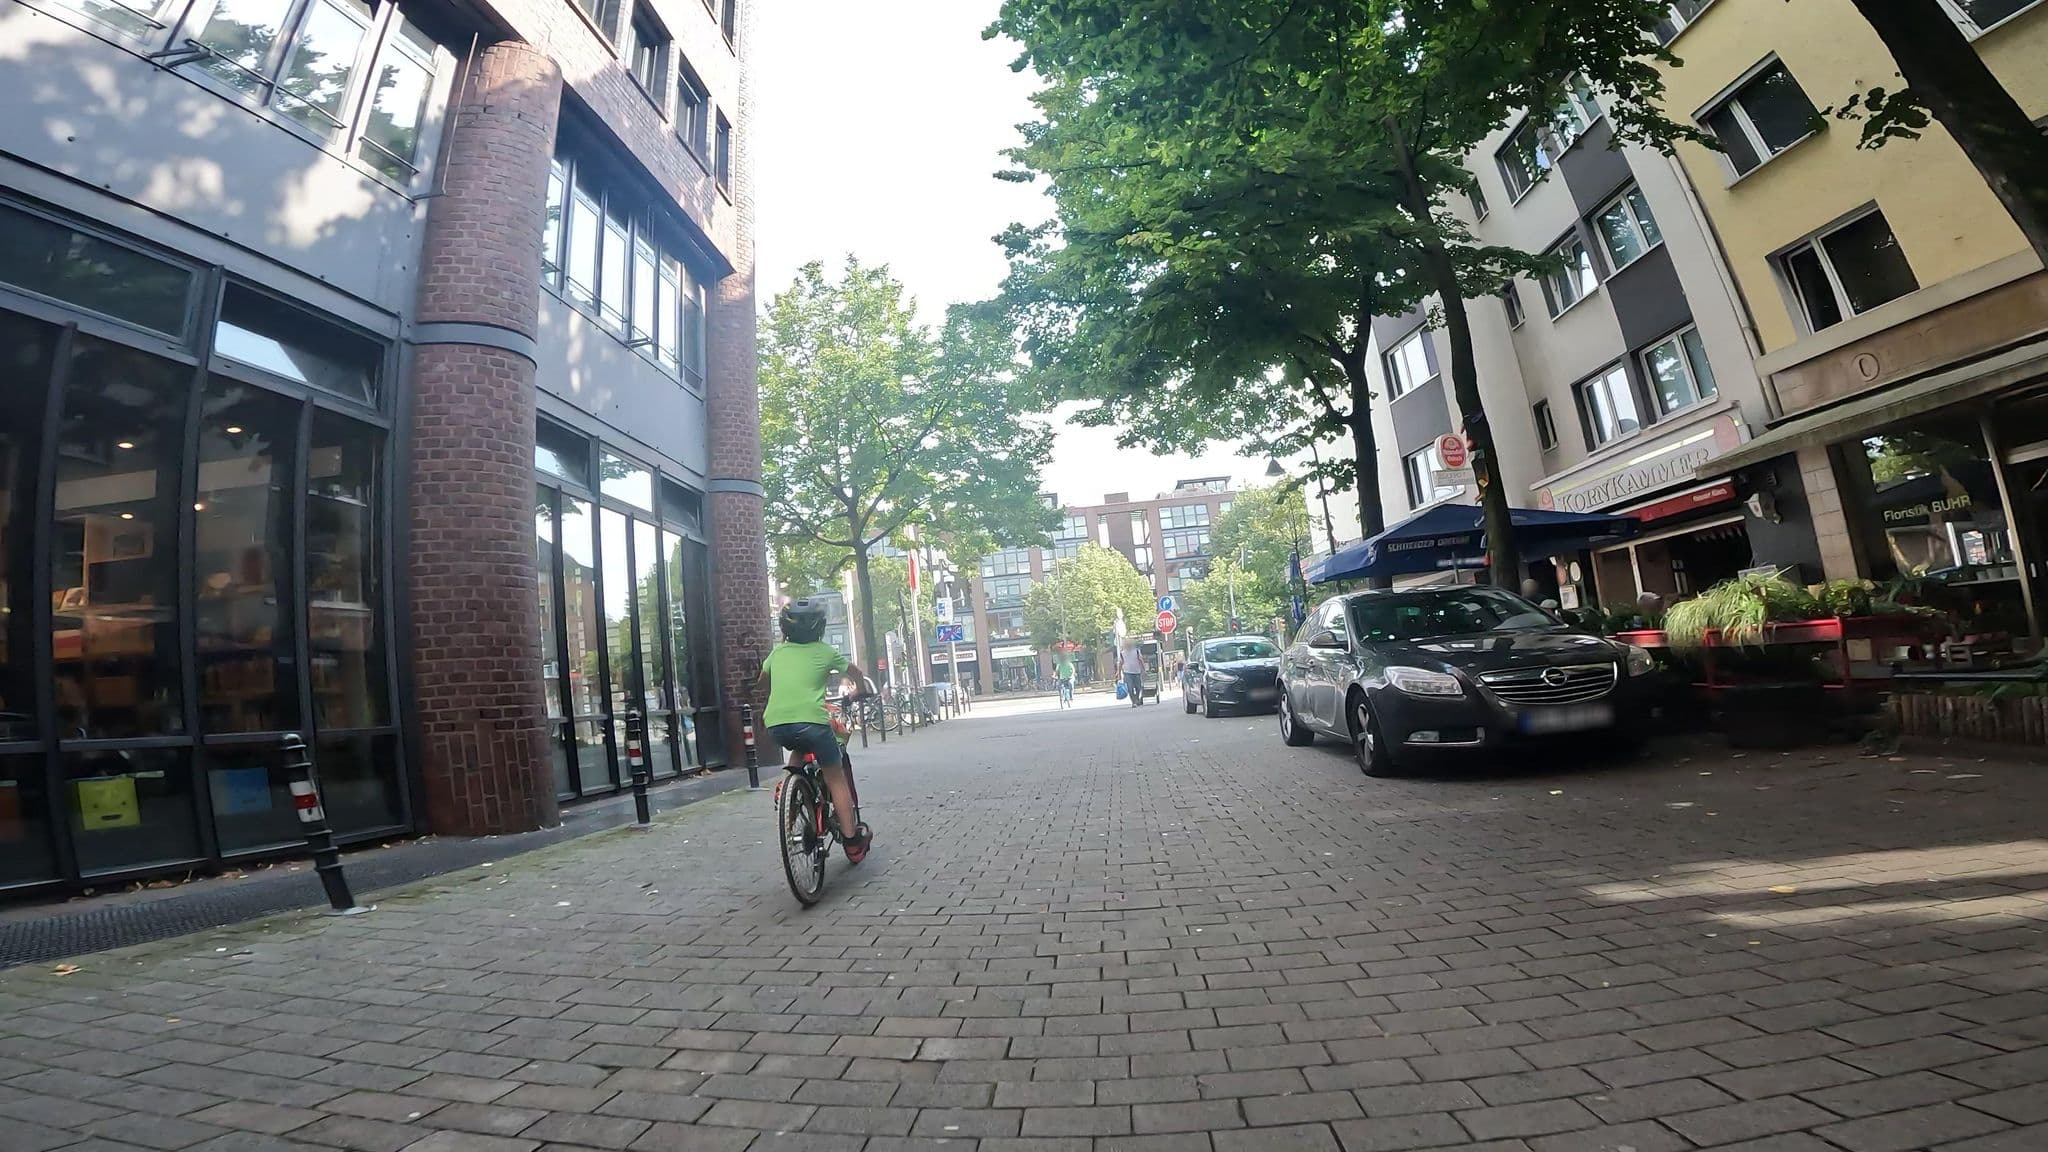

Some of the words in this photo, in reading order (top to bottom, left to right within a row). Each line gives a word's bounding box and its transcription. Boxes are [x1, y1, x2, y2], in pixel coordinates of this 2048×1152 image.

[1884, 503, 1930, 521] Floristik
[1932, 495, 1971, 513] BUHR
[1158, 617, 1174, 628] STOP
